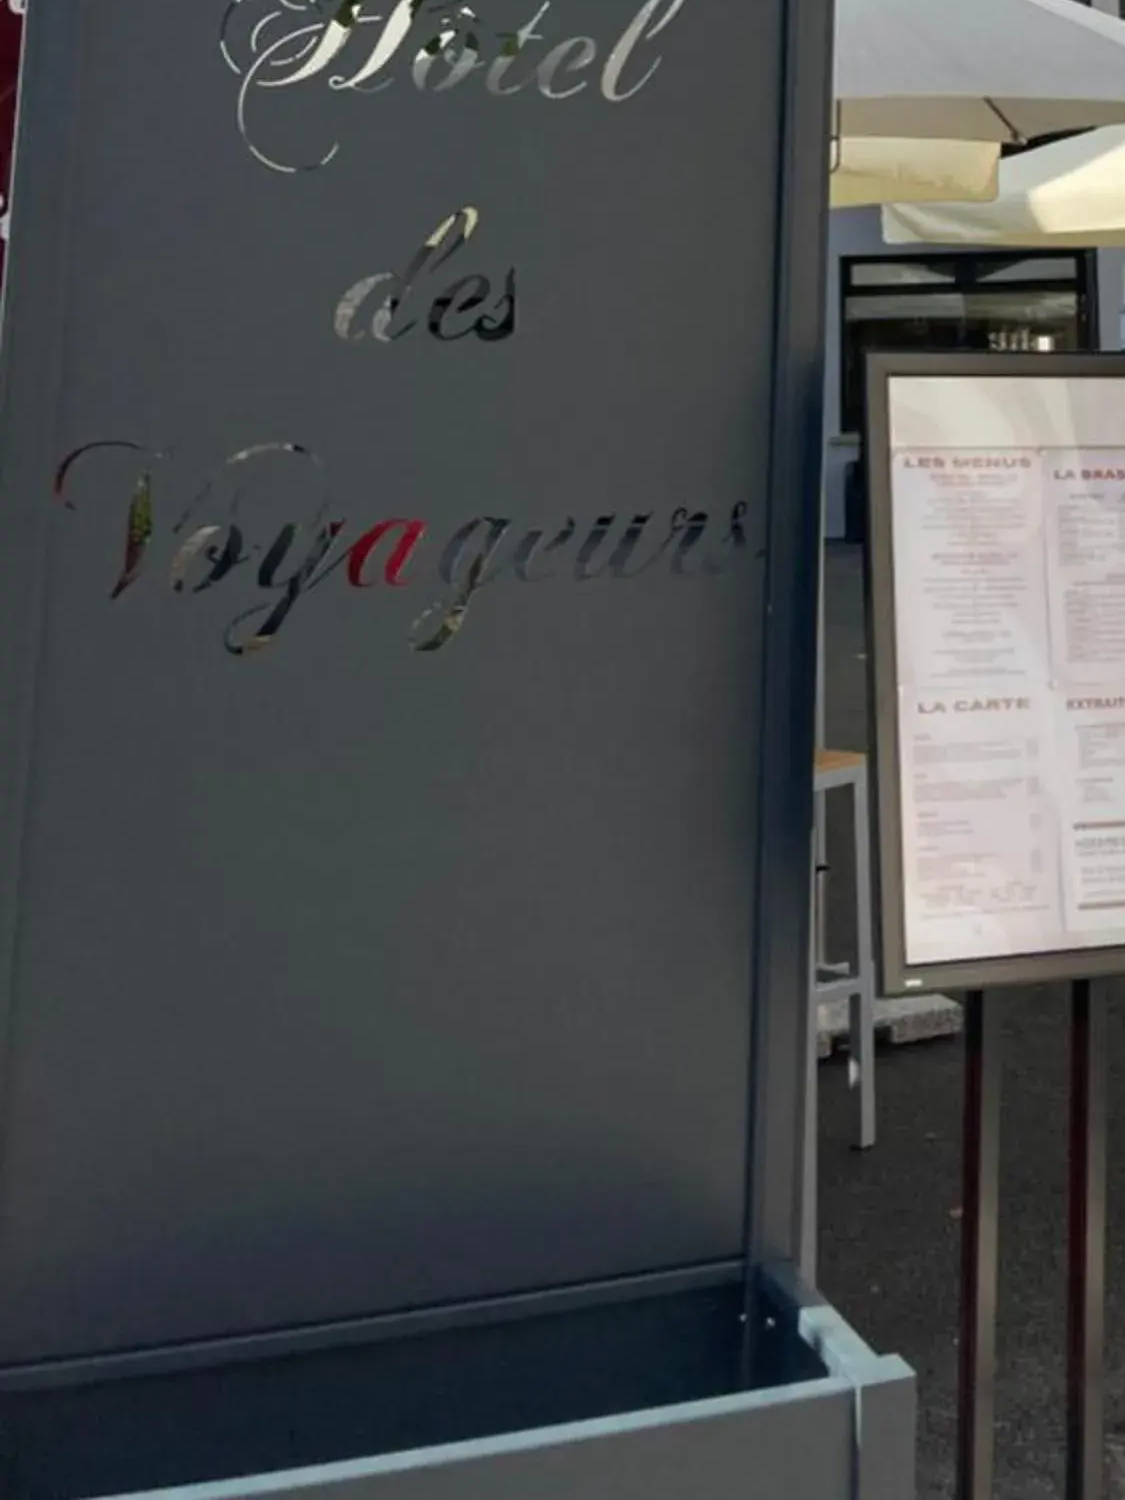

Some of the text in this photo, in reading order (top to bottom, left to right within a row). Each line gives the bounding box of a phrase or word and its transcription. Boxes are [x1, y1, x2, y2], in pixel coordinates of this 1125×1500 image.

[333, 206, 517, 342] des
[1054, 470, 1078, 481] LA
[54, 440, 768, 656] Voyageurs
[917, 697, 1030, 715] LA CARTE
